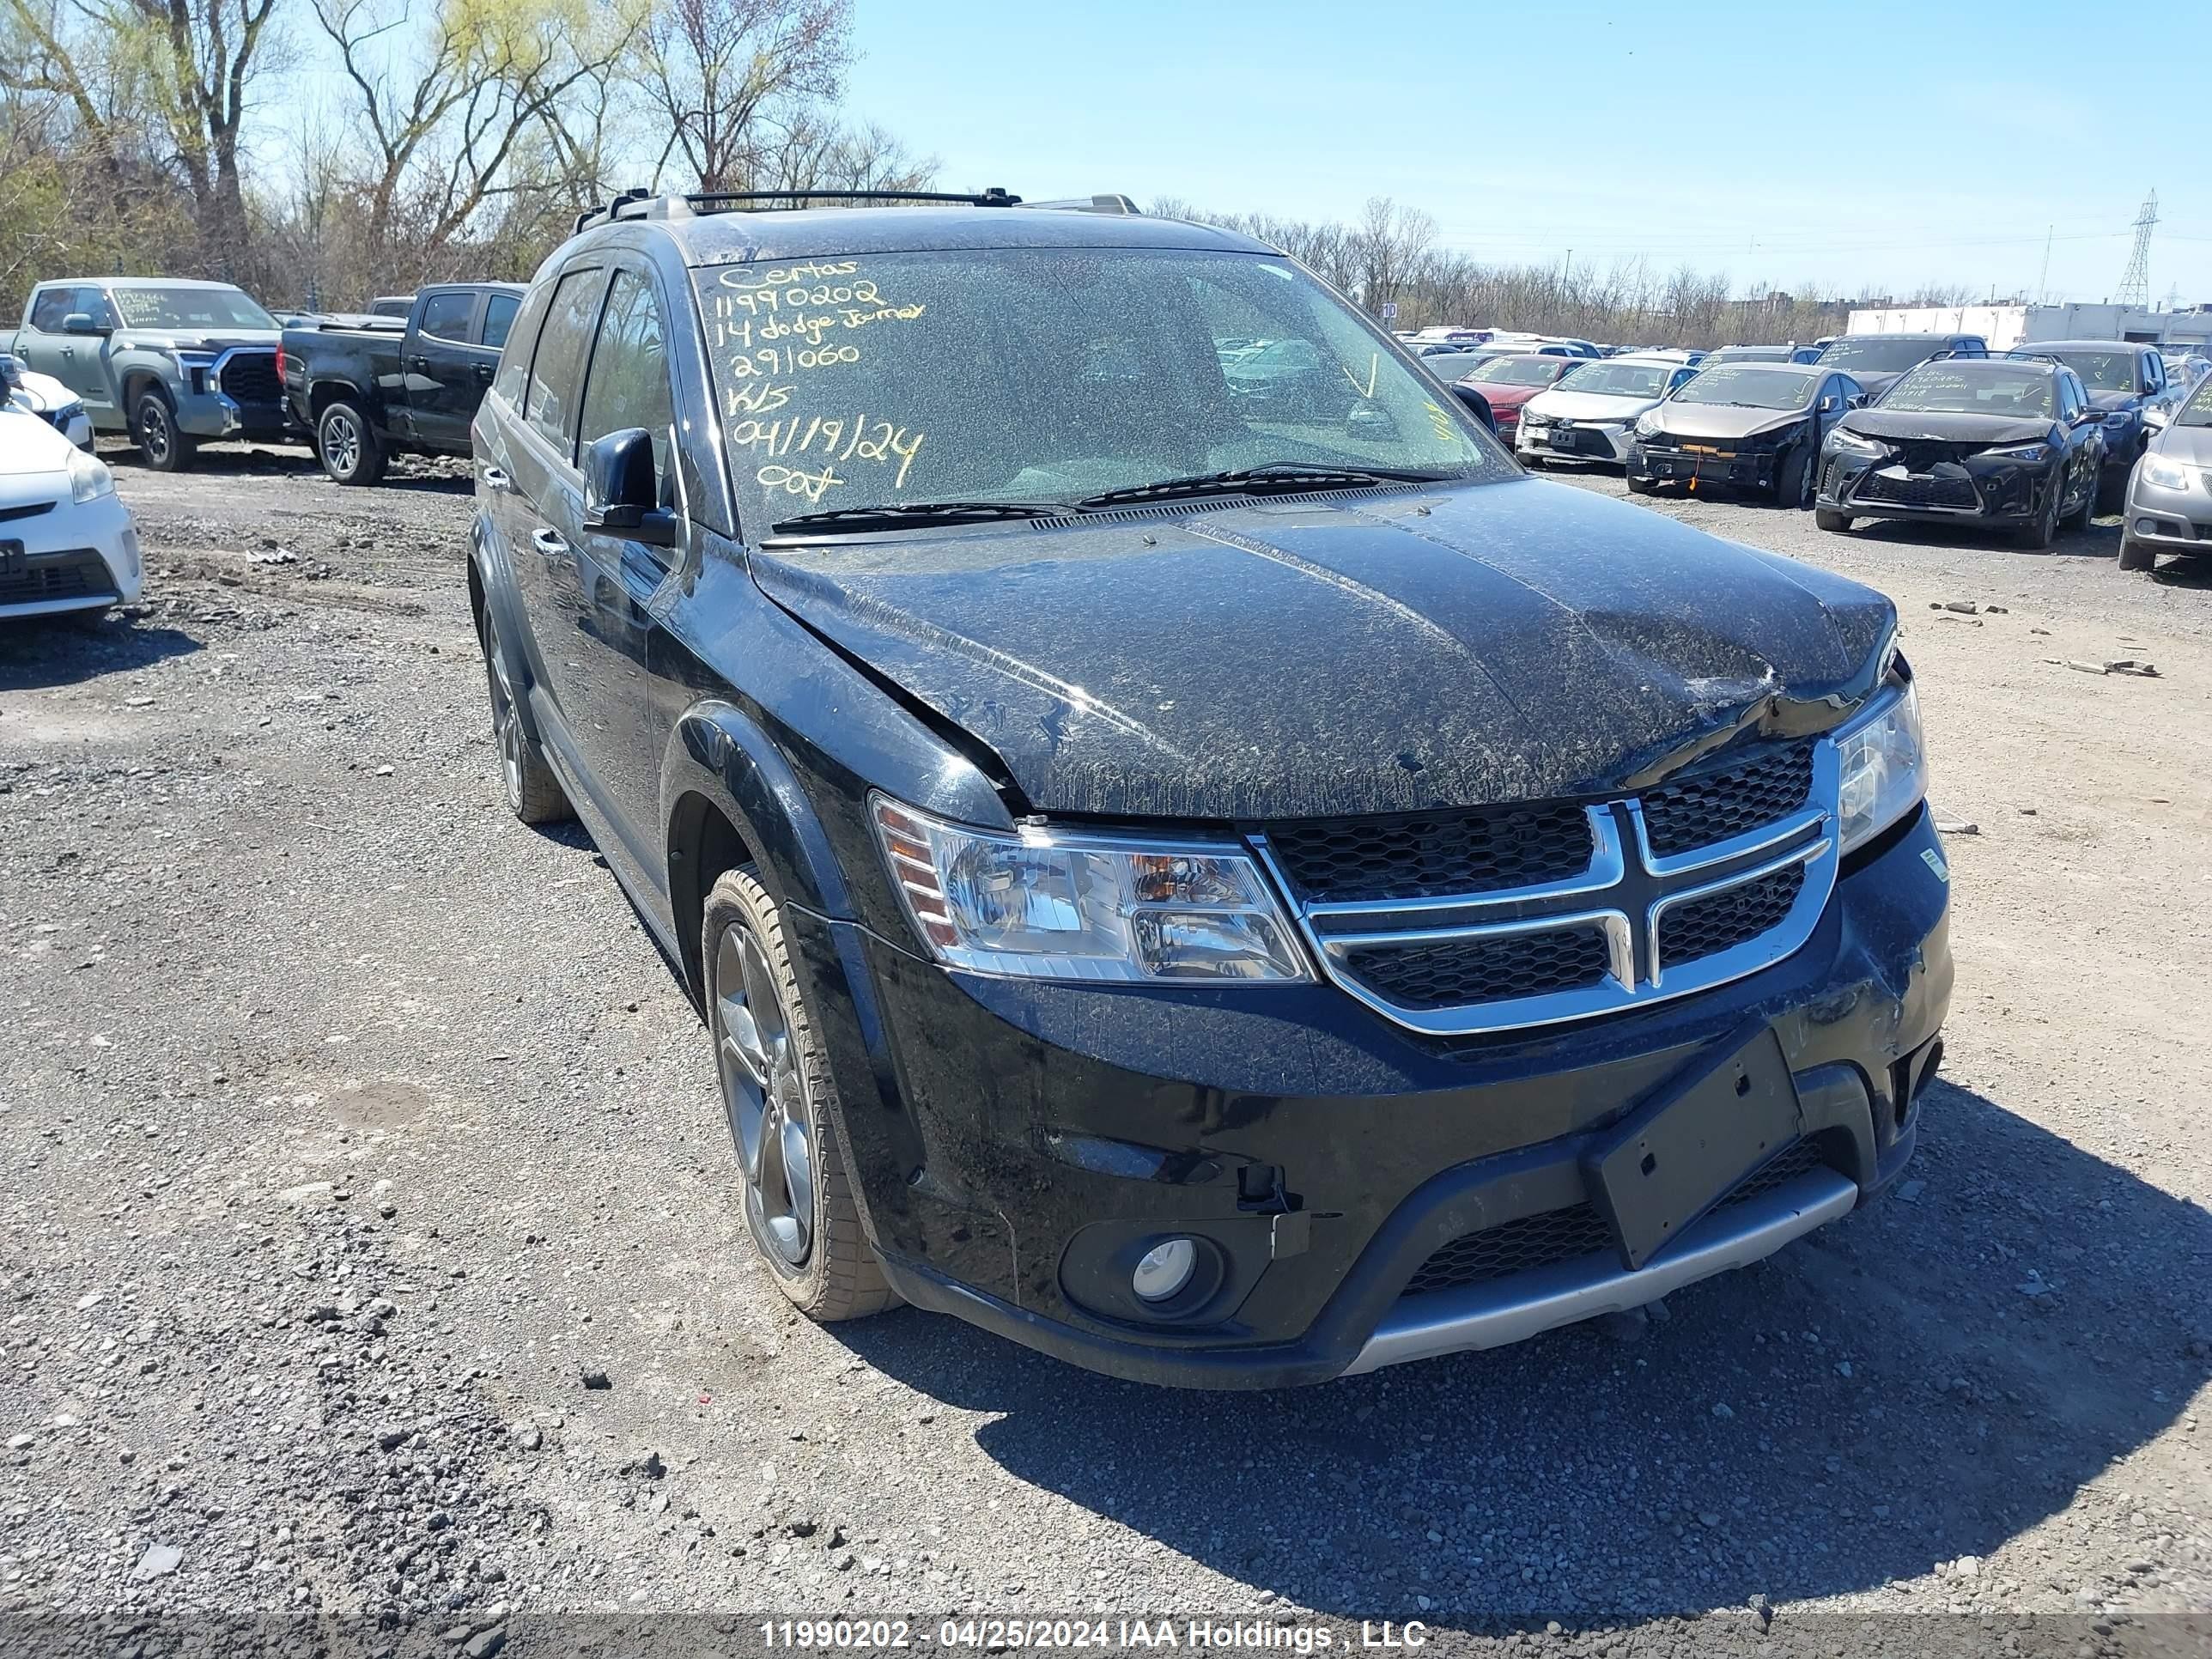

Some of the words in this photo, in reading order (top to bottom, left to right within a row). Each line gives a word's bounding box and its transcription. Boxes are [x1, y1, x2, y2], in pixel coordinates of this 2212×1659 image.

[716, 280, 887, 317] 11990202
[718, 323, 751, 347] 14
[731, 345, 860, 378] 291060
